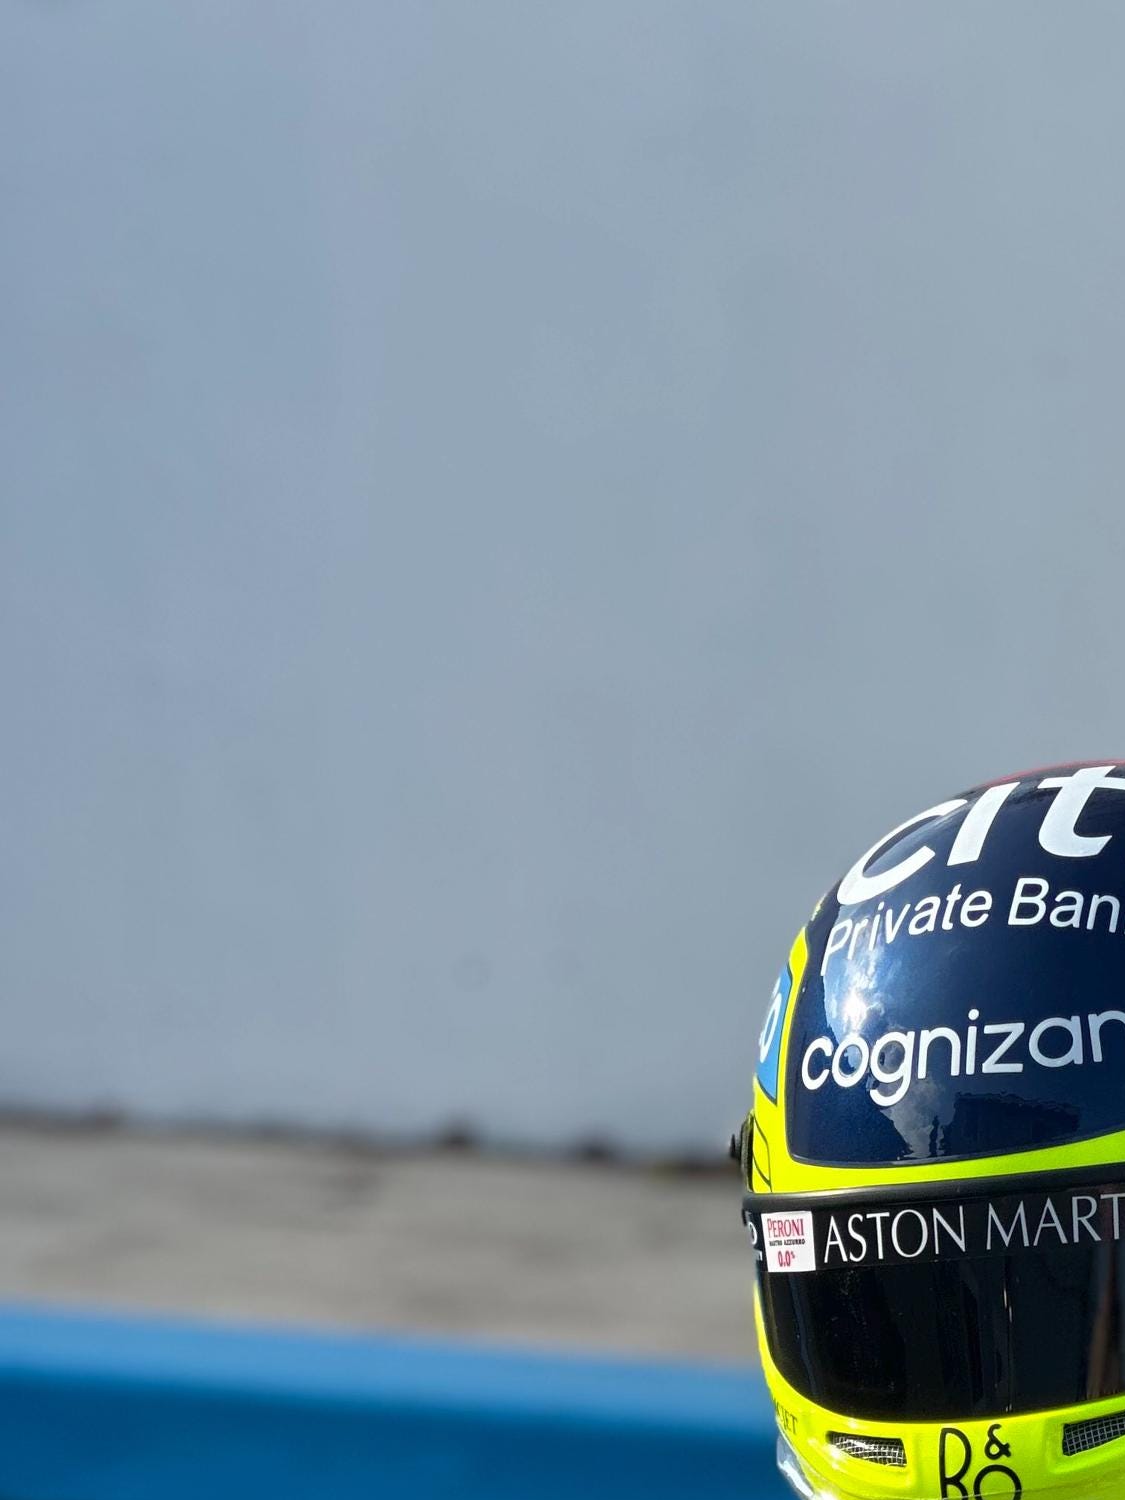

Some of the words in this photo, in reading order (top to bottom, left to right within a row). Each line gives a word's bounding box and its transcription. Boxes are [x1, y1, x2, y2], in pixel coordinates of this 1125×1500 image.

[819, 883, 992, 977] Private
[767, 1218, 804, 1239] PERONI
[824, 1206, 967, 1264] ASTON
